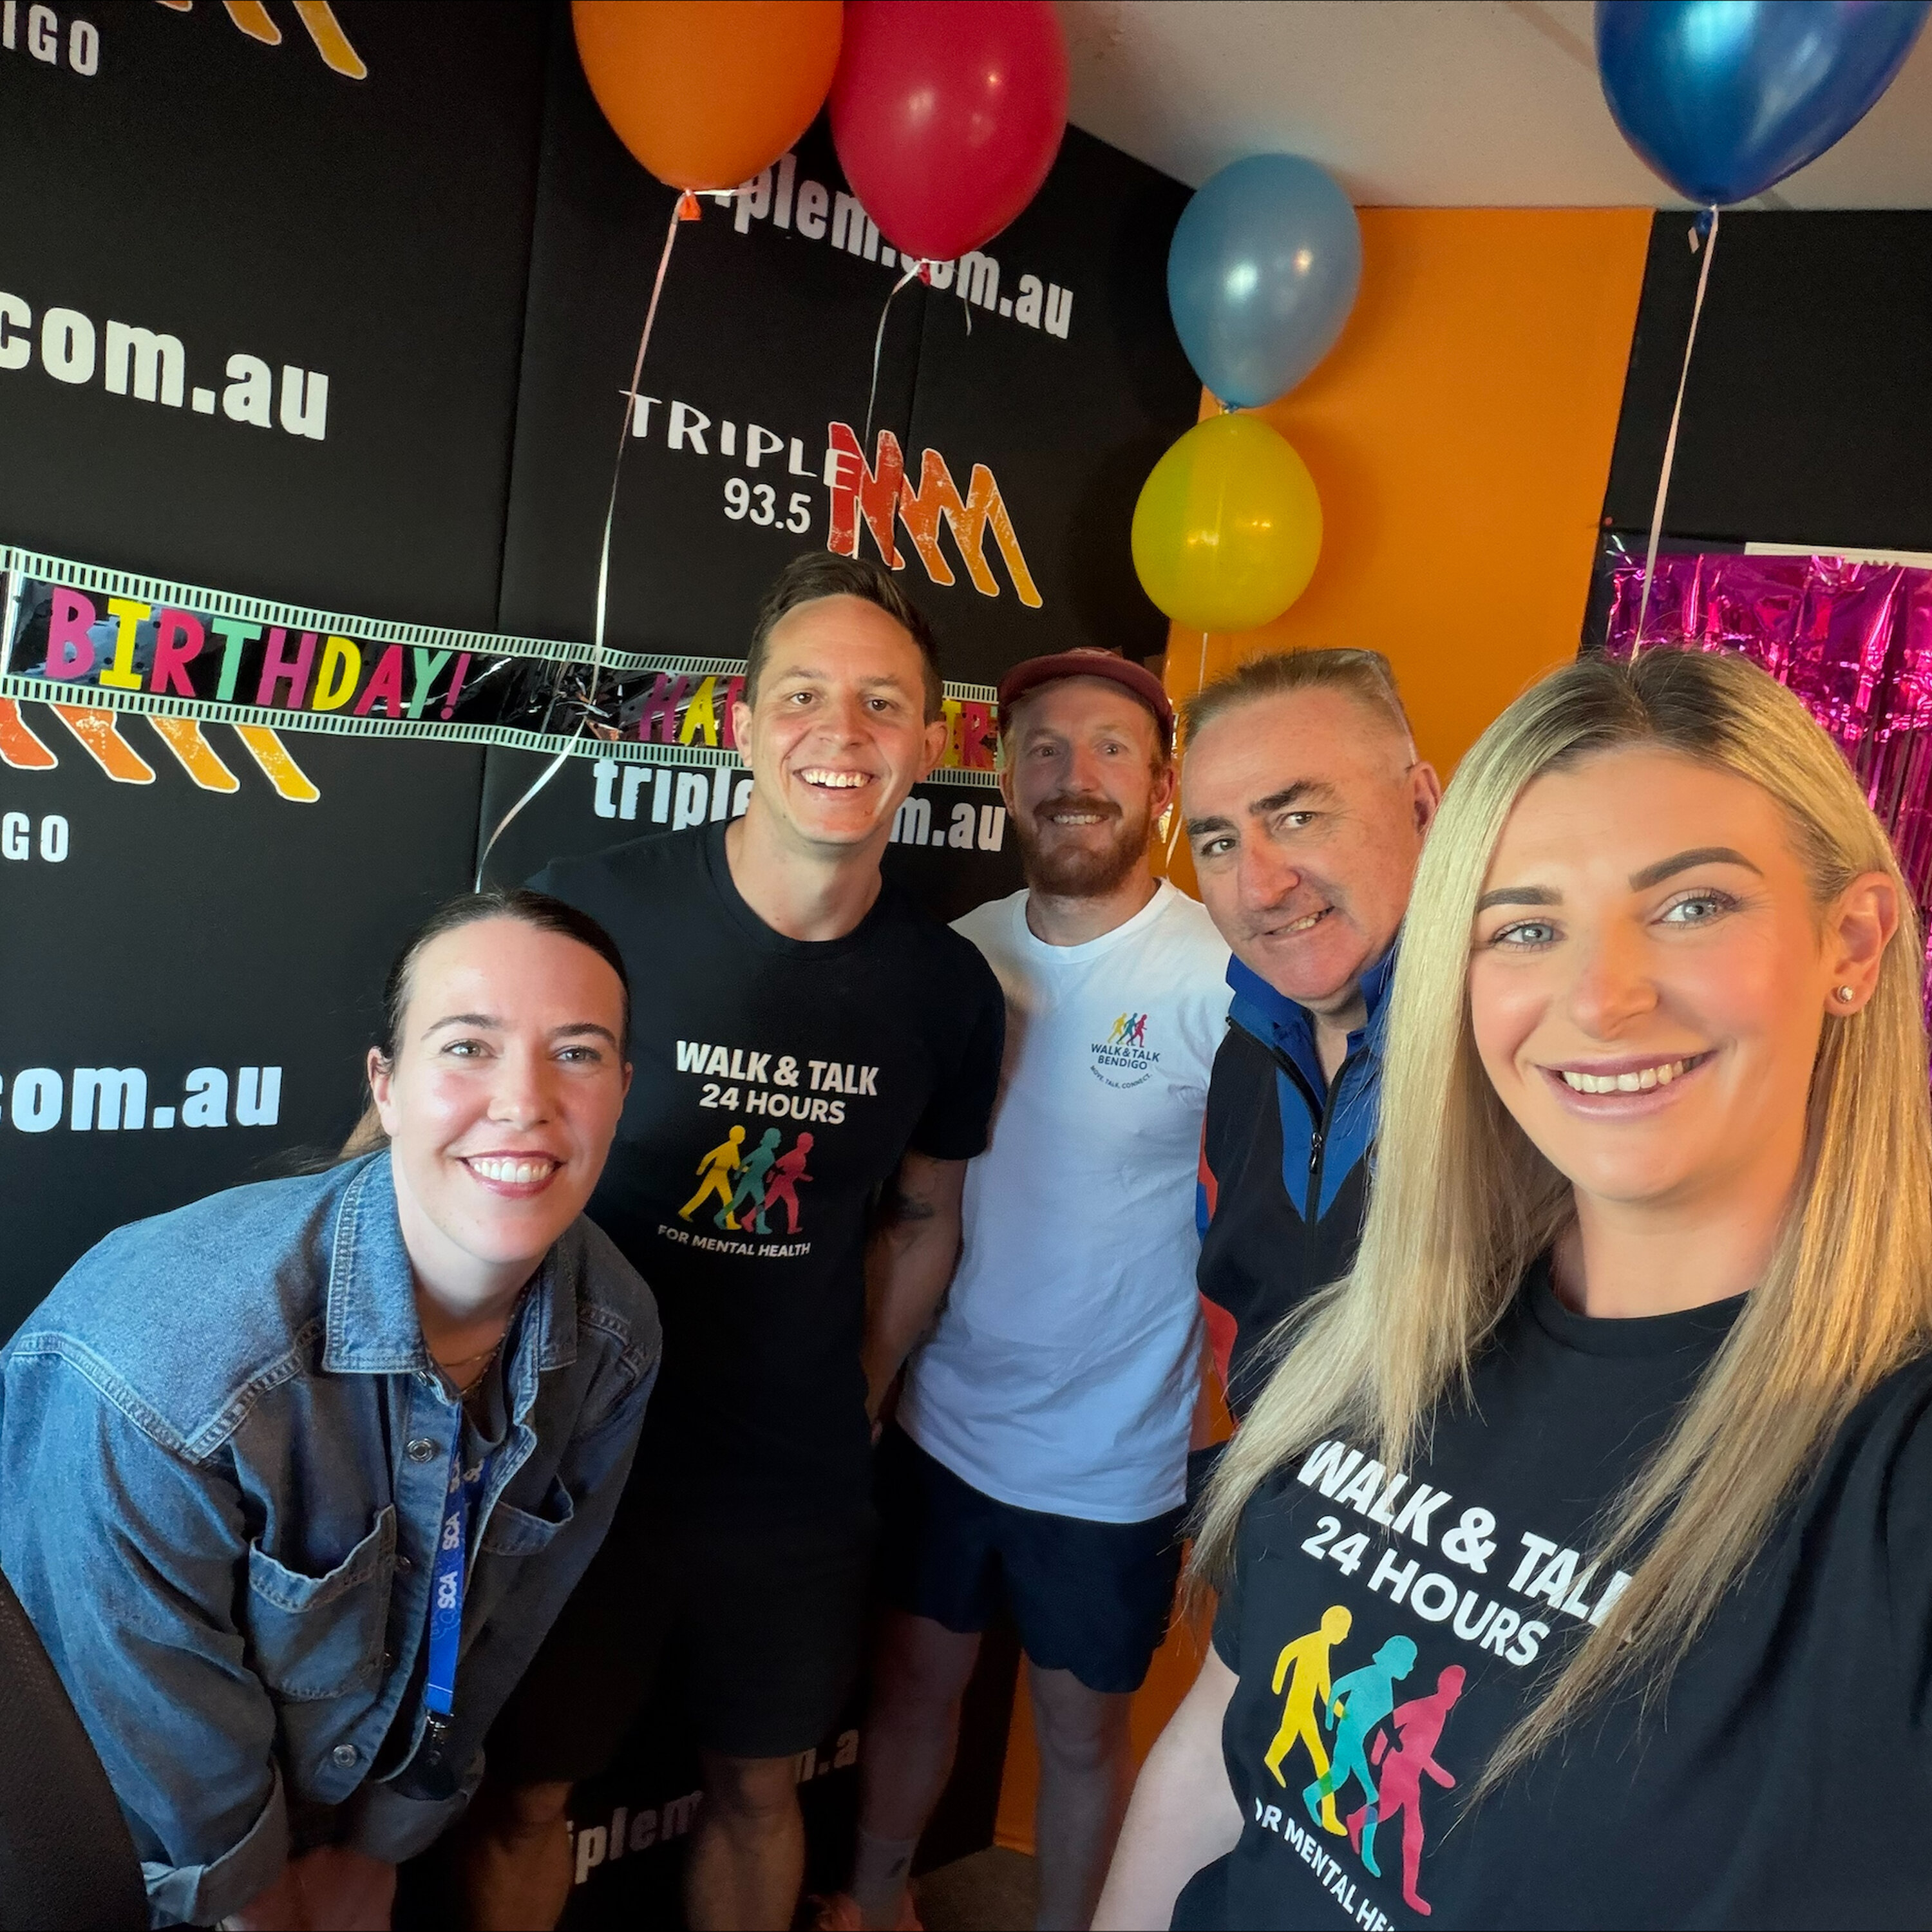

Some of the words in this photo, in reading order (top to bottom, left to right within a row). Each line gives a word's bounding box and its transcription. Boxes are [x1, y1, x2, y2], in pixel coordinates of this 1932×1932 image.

[619, 389, 860, 491] TRIPLE
[723, 477, 811, 534] 93.5
[44, 587, 471, 721] BIRTHDAY!
[676, 1040, 772, 1084] WALK
[773, 1056, 800, 1088] &
[808, 1060, 880, 1096] TALK
[1091, 1043, 1122, 1057] WALK
[1132, 1048, 1161, 1063] TALK
[1097, 1055, 1148, 1070] BENDIGO
[0, 1066, 282, 1133] om.au
[699, 1083, 740, 1112] 24
[744, 1090, 846, 1125] HOURS
[657, 1224, 689, 1244] FOR
[692, 1235, 755, 1256] MENTAL
[757, 1242, 811, 1258] HEALTH
[441, 1511, 460, 1551] SCA
[1296, 1440, 1453, 1547] WALK
[1440, 1506, 1498, 1574] &
[437, 1570, 459, 1609] SCA
[1300, 1515, 1370, 1577] 24
[1367, 1548, 1550, 1667] HOURS
[1283, 1817, 1357, 1915] MENTAL
[1355, 1897, 1395, 1931] HE
